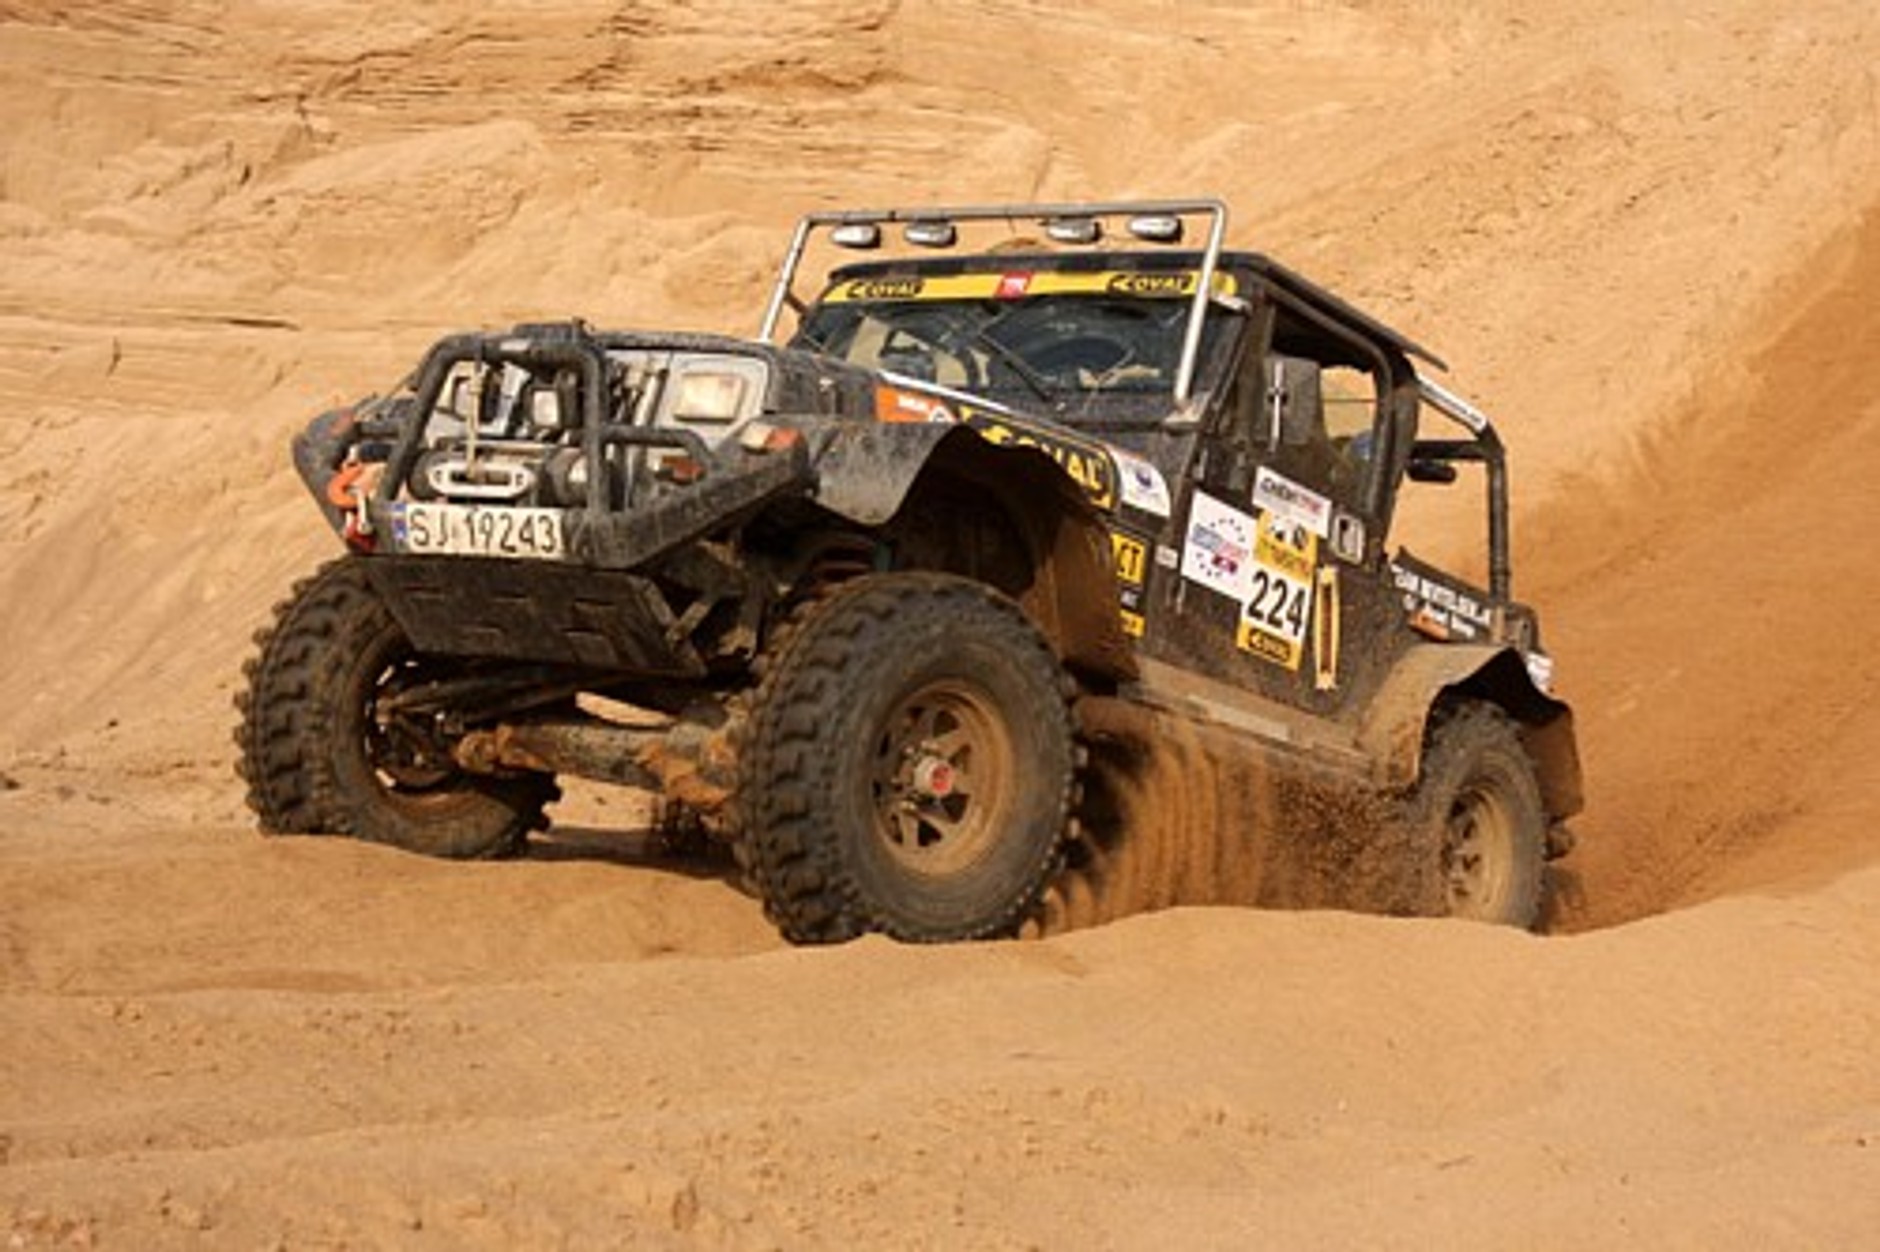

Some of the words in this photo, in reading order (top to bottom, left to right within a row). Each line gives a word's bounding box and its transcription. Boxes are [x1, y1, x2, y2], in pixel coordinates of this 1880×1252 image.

[410, 508, 448, 547] SJ
[464, 510, 558, 554] 19243
[1248, 568, 1305, 637] 224
